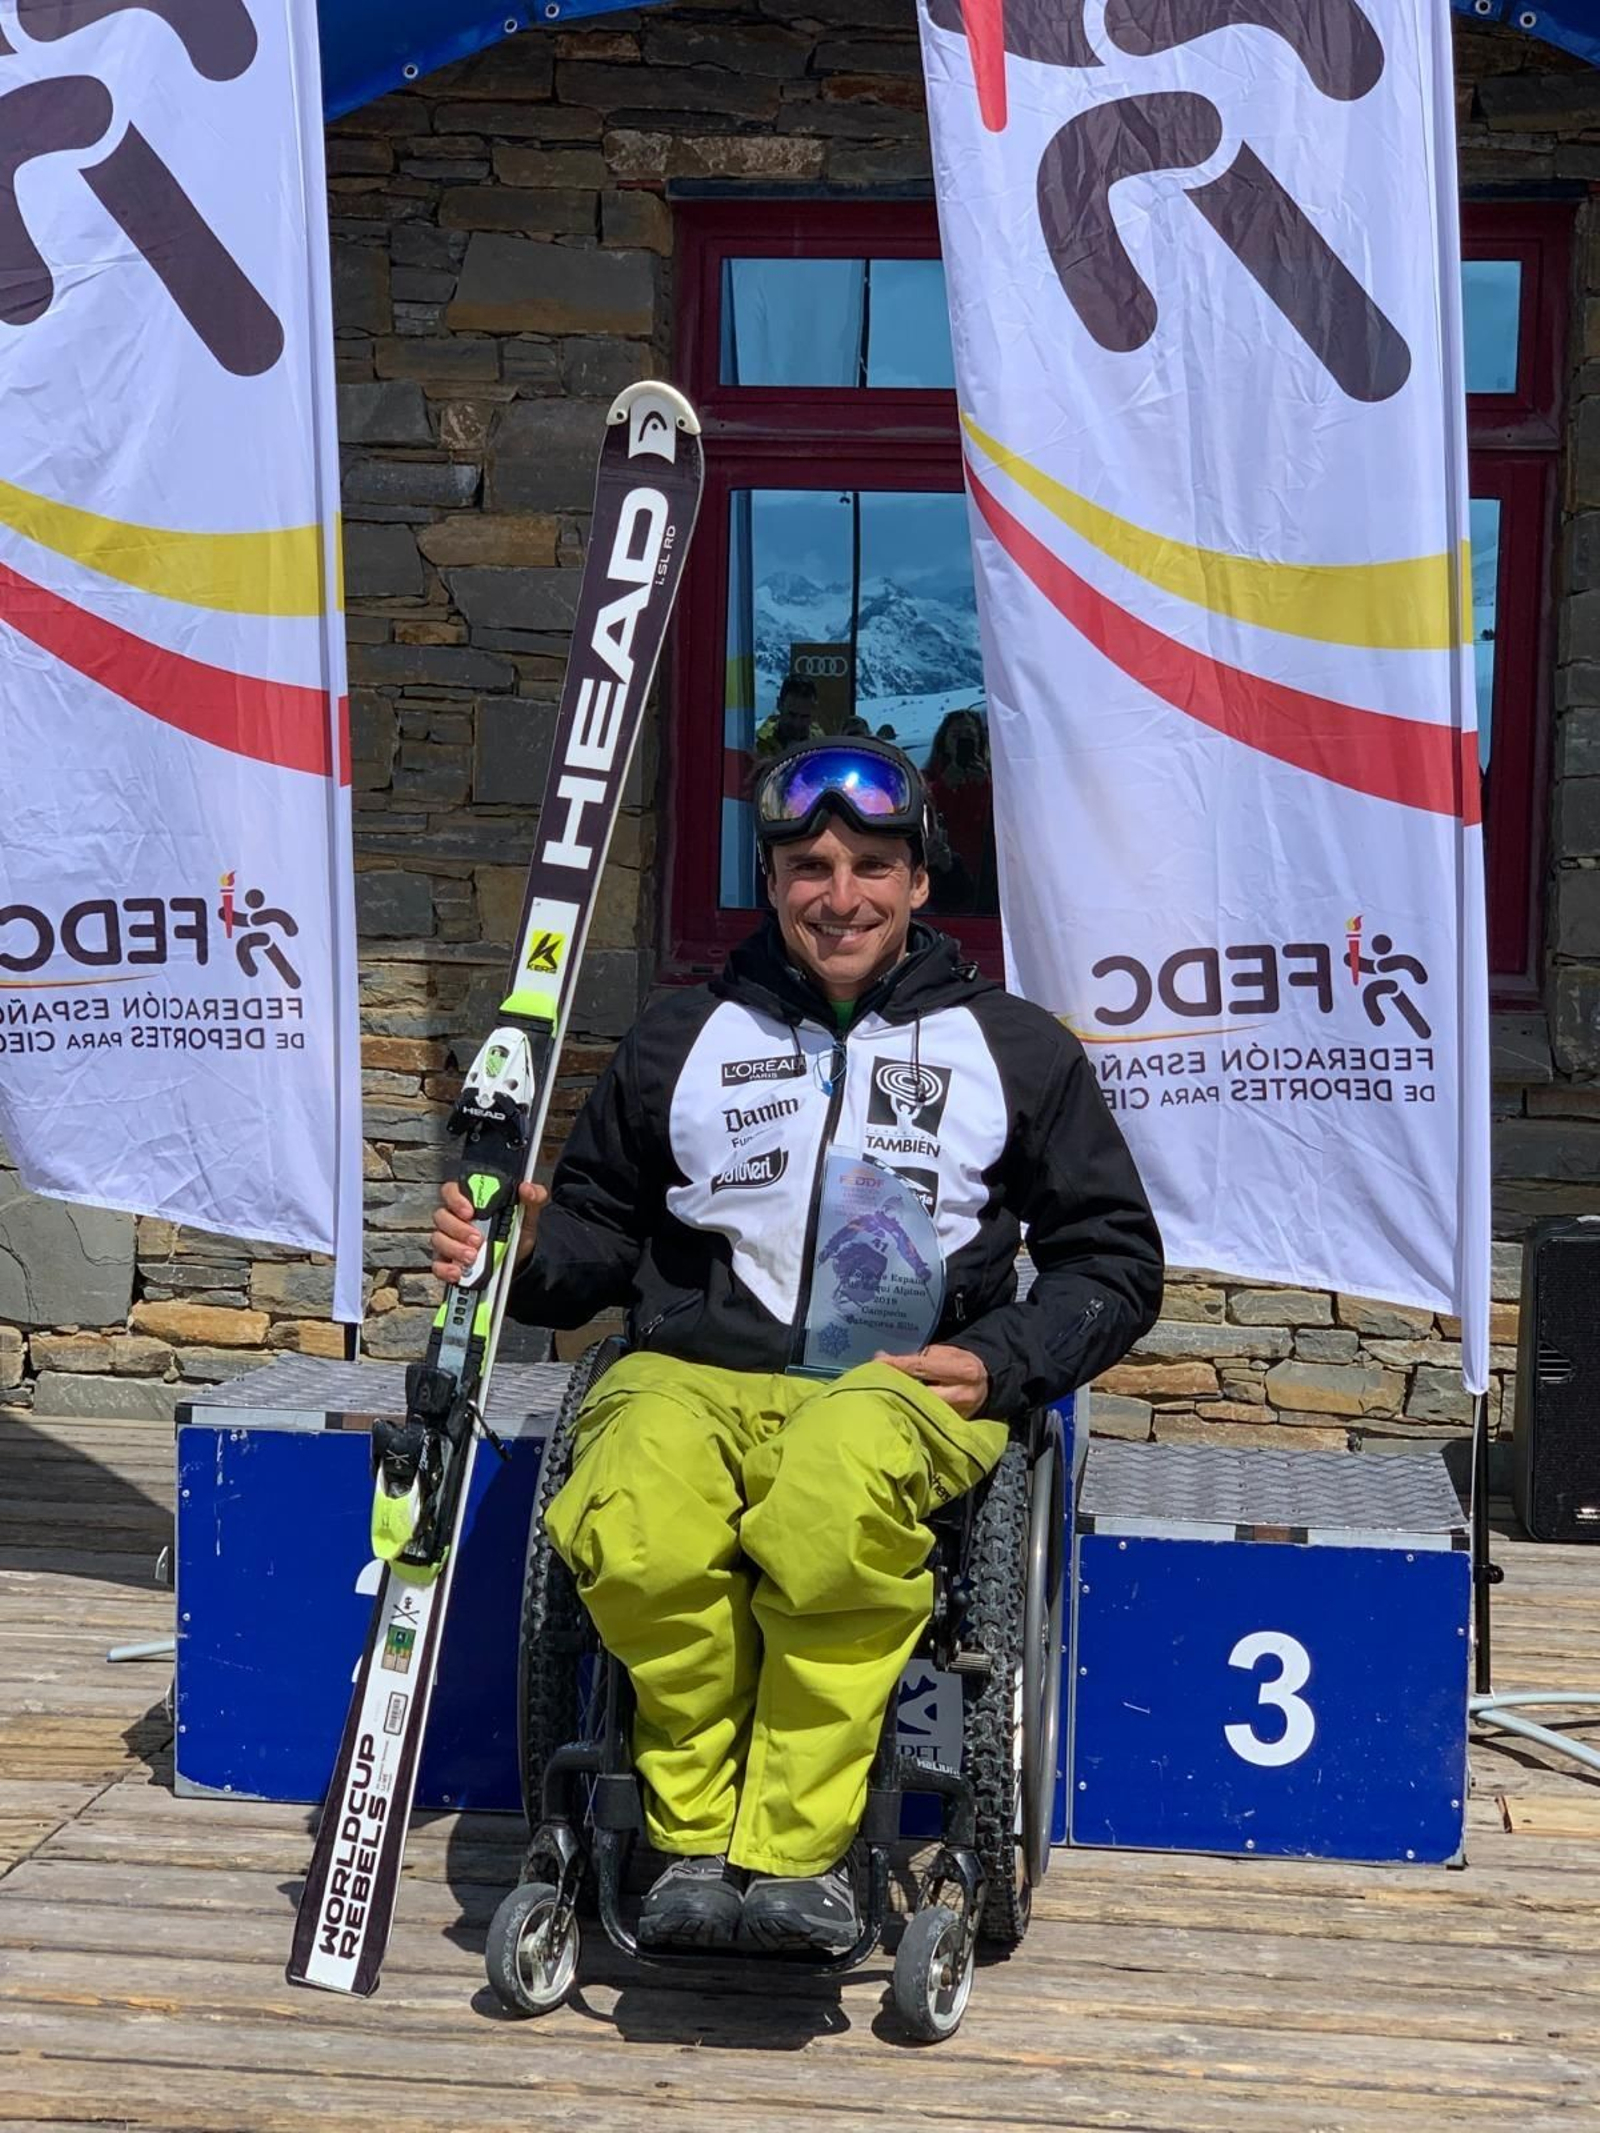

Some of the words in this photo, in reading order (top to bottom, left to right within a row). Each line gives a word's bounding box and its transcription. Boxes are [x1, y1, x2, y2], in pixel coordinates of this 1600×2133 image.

[663, 524, 677, 550] RD
[541, 487, 669, 870] HEAD
[463, 1105, 506, 1121] HEAD
[721, 1098, 799, 1133] Damm
[1223, 1631, 1316, 1767] 3
[318, 1733, 375, 1953] WORLDCUP
[338, 1796, 387, 1960] REBELS
